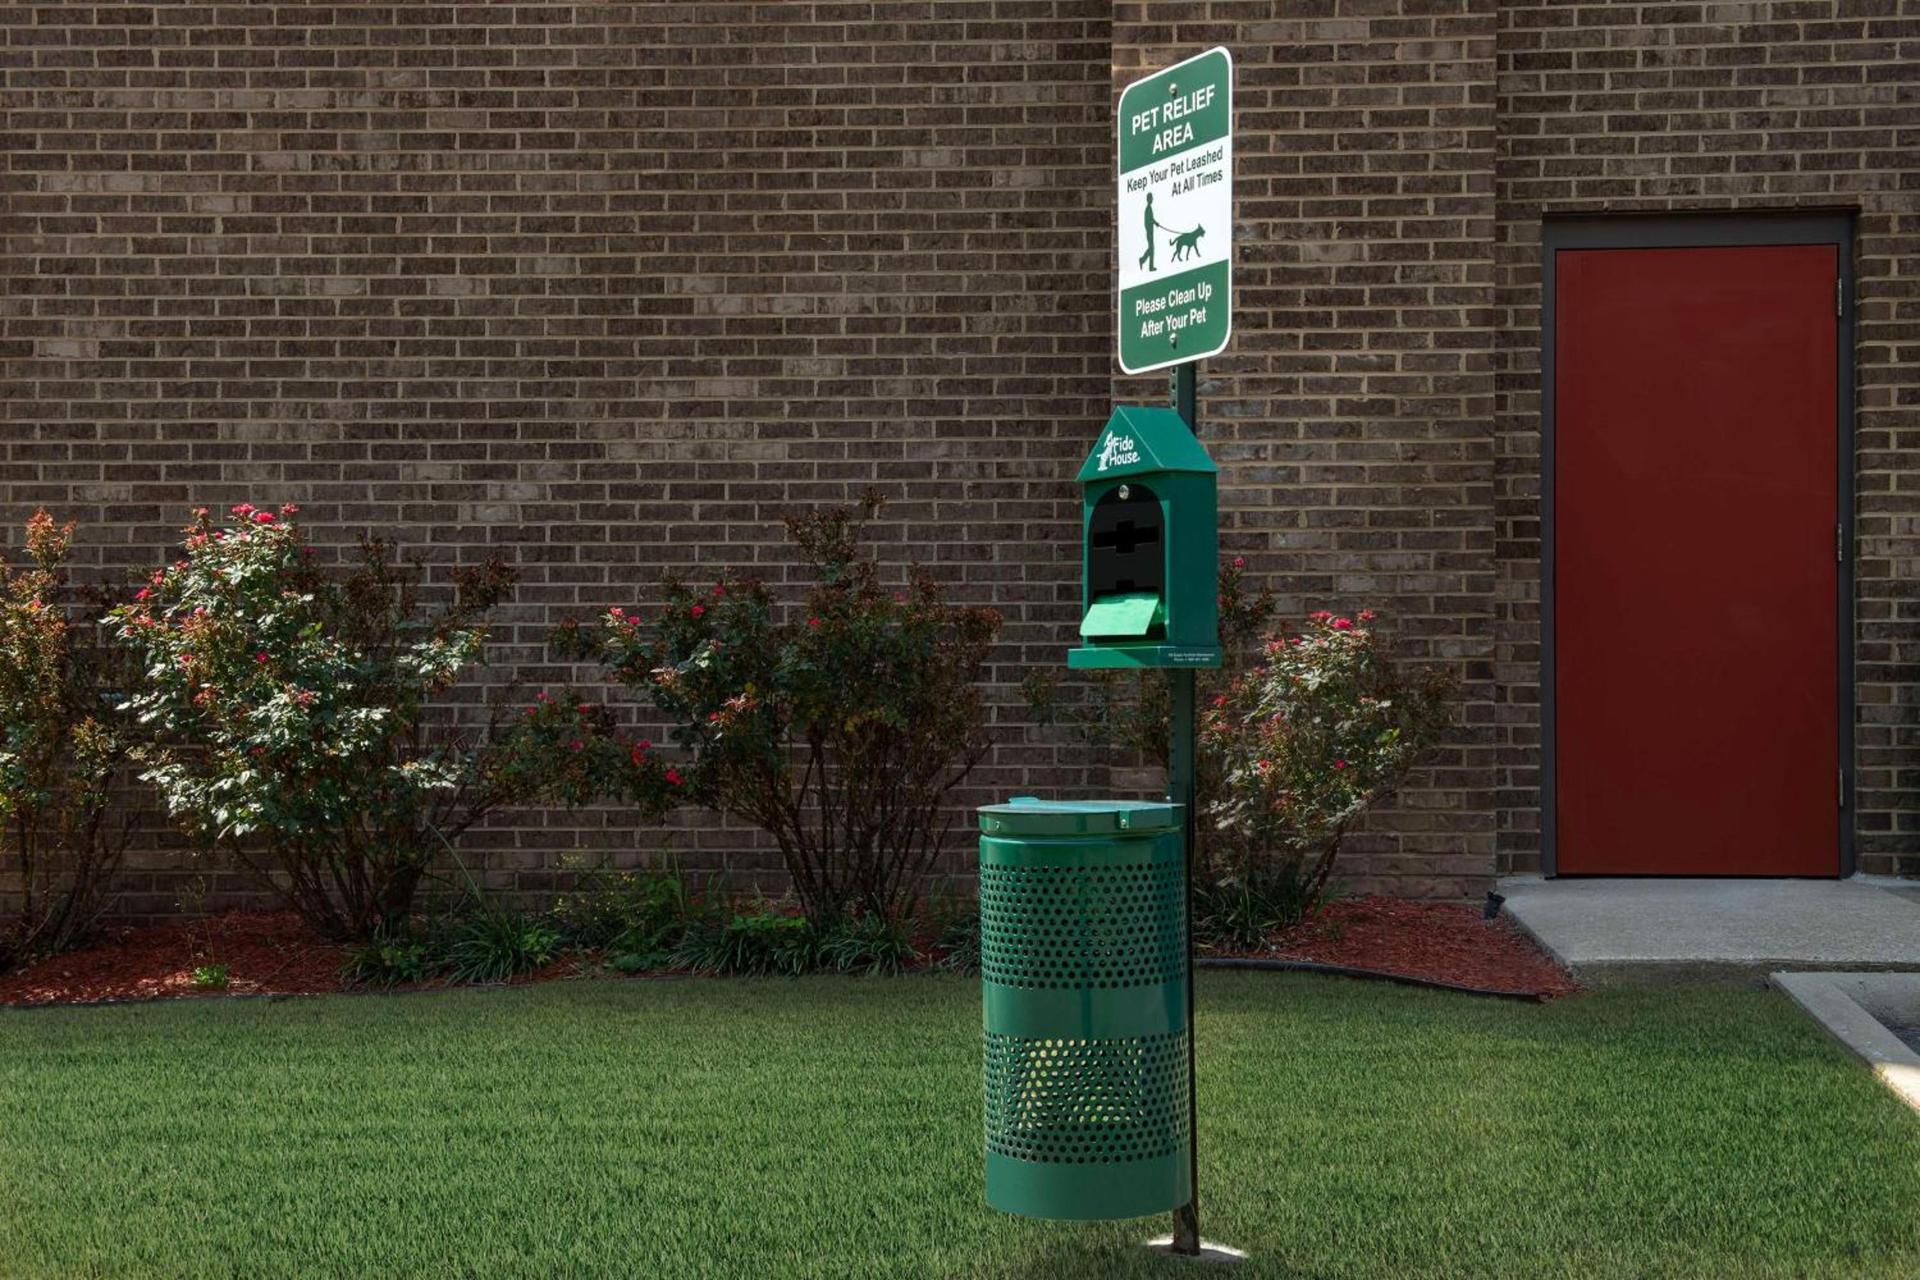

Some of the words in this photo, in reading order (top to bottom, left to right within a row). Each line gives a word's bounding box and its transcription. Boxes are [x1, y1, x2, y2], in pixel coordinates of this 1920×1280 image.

[1132, 107, 1159, 135] PET
[1163, 84, 1215, 123] RELIEF
[1152, 122, 1194, 155] AREA
[1127, 176, 1147, 193] Keep
[1149, 168, 1168, 184] Your
[1170, 161, 1184, 178] Pet
[1186, 145, 1223, 171] Leashed
[1171, 182, 1181, 197] At
[1183, 176, 1195, 193] All
[1197, 169, 1223, 187] Times
[1136, 296, 1166, 317] Please
[1168, 289, 1195, 307] Clean
[1197, 281, 1212, 302] Up
[1140, 319, 1164, 339] After
[1165, 314, 1188, 331] Your
[1190, 306, 1206, 326] Pet
[1109, 451, 1140, 466] House
[1113, 435, 1134, 451] Fido
